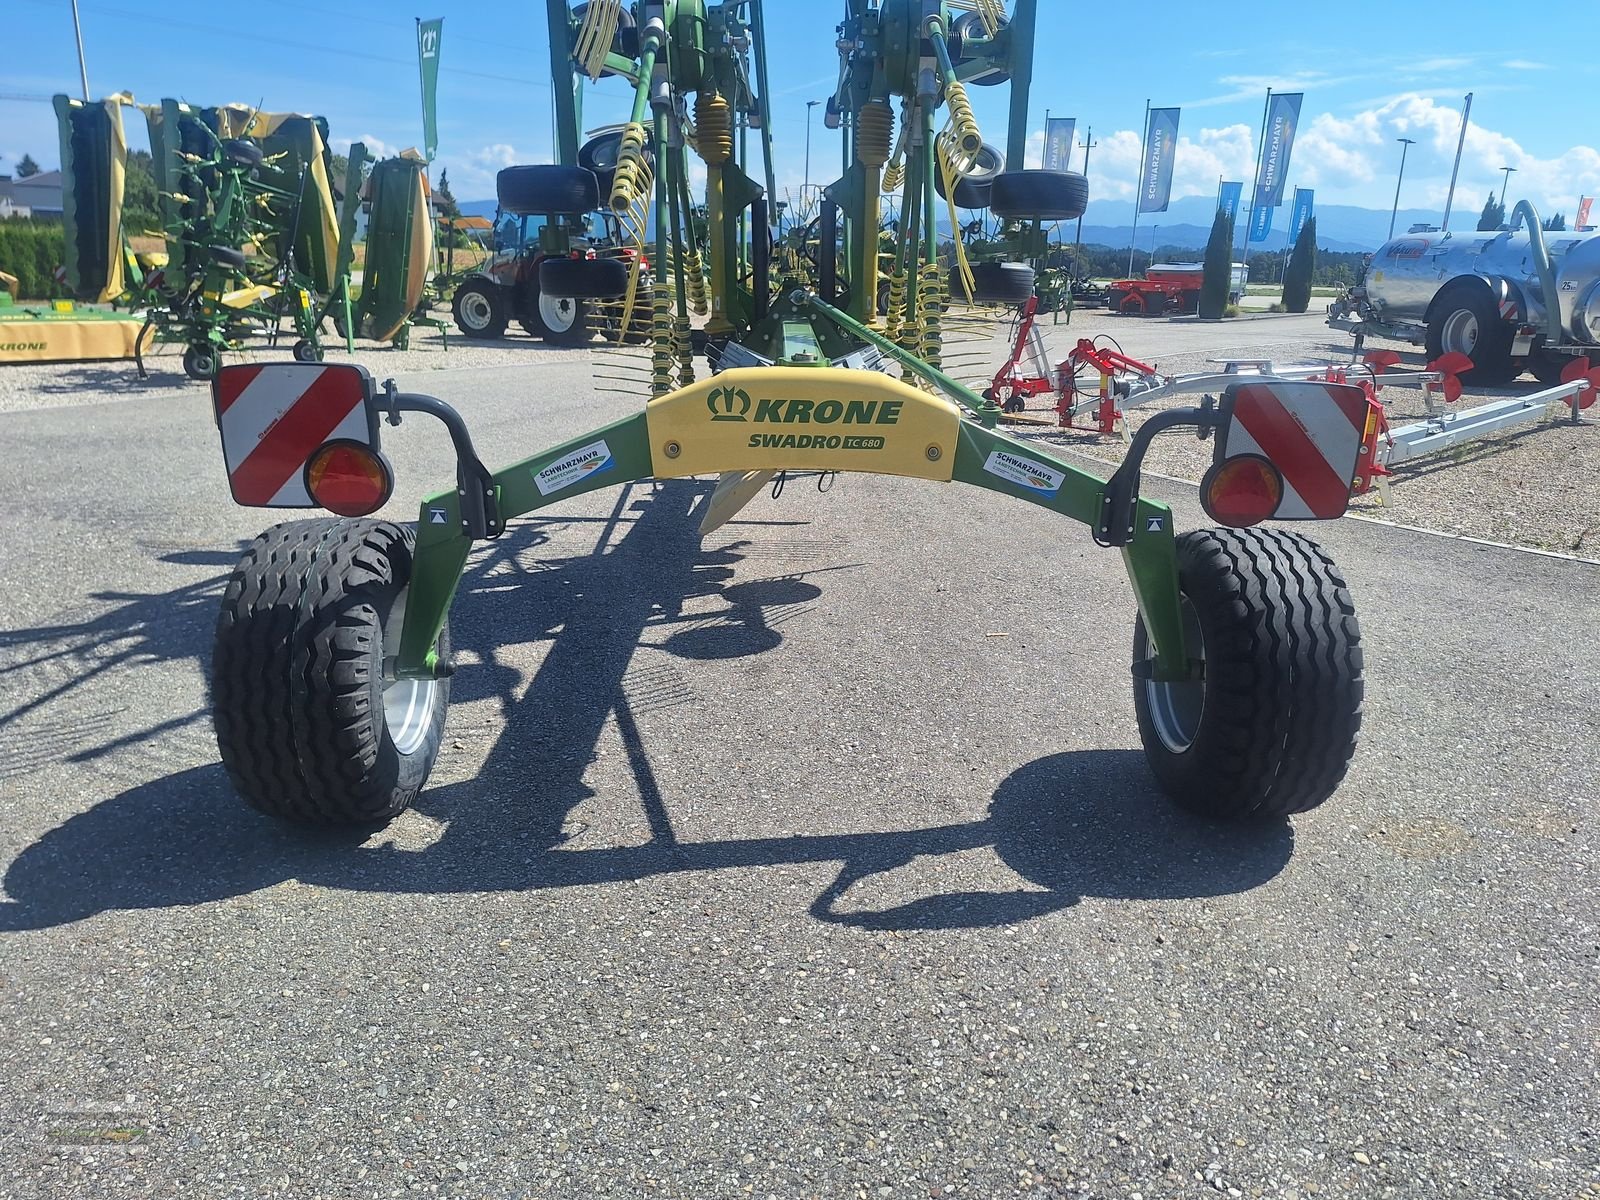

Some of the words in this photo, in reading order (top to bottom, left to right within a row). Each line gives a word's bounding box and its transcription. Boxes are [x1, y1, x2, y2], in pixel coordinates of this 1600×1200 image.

[1148, 128, 1162, 200] SCHWARZMAYR
[1265, 116, 1283, 192] SCHWARZMAYR
[1561, 281, 1571, 290] 25
[753, 399, 904, 424] KRONE
[748, 434, 842, 449] SWADRO
[847, 438, 860, 447] TC
[861, 439, 881, 448] 680
[539, 450, 599, 479] SCHWARZMAYR
[996, 452, 1053, 482] SCHWARZMAYR
